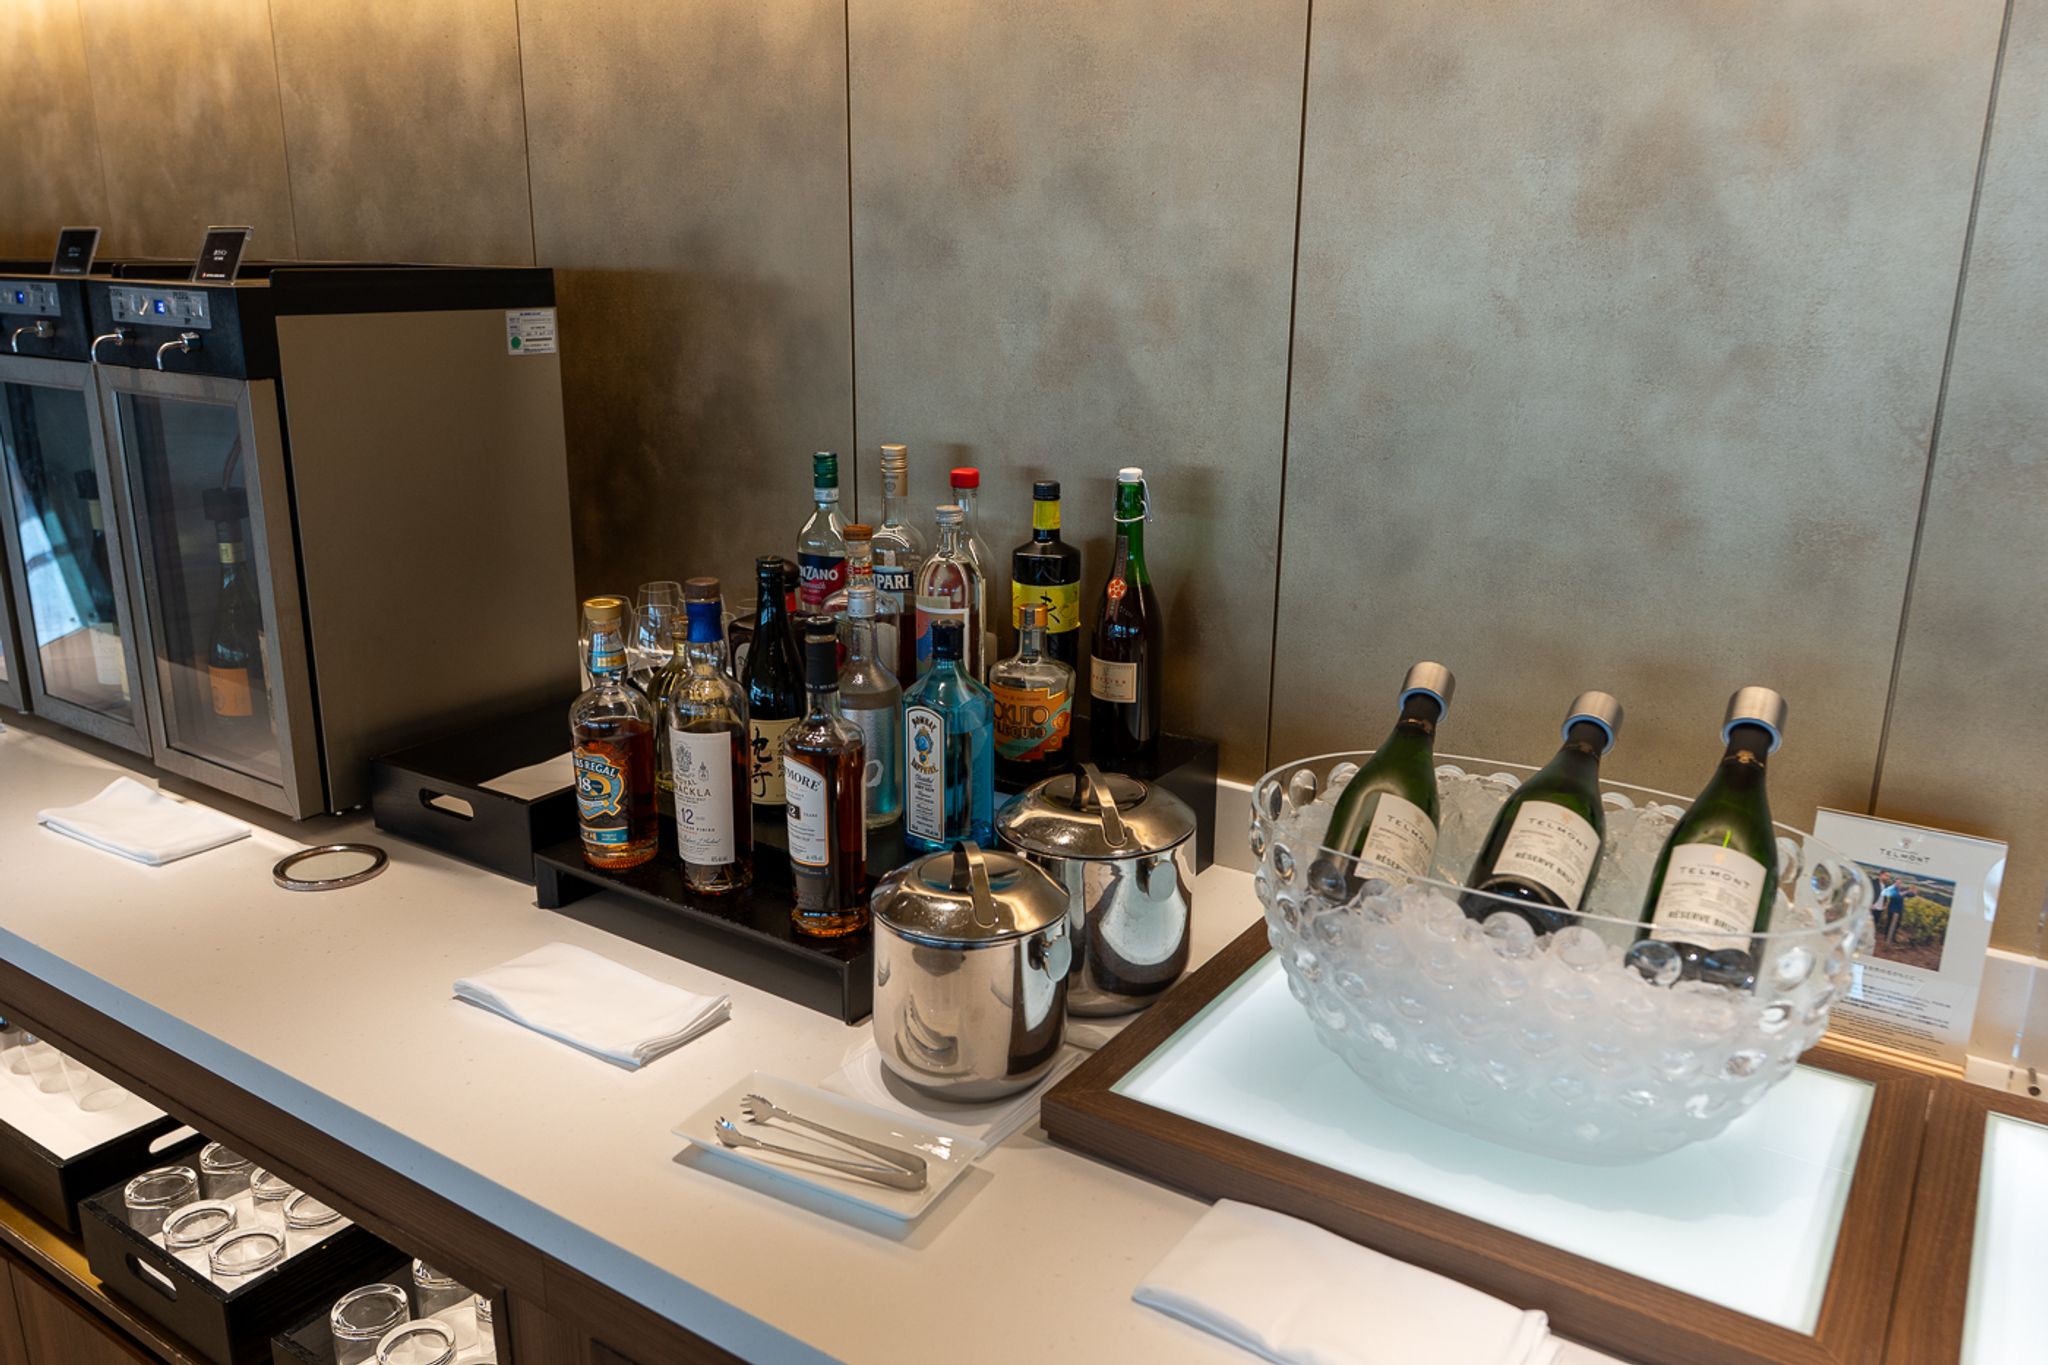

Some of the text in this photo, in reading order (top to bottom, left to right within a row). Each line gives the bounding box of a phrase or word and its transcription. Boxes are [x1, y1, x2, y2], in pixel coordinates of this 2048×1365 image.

[873, 574, 911, 589] PARI
[585, 761, 618, 777] REGAL
[578, 775, 592, 792] 18
[681, 807, 695, 825] 12
[1386, 814, 1432, 855] TELMONT
[1529, 817, 1589, 851] TELMONT
[1880, 847, 1931, 862] TELMONT
[1680, 866, 1751, 889] TELMONT
